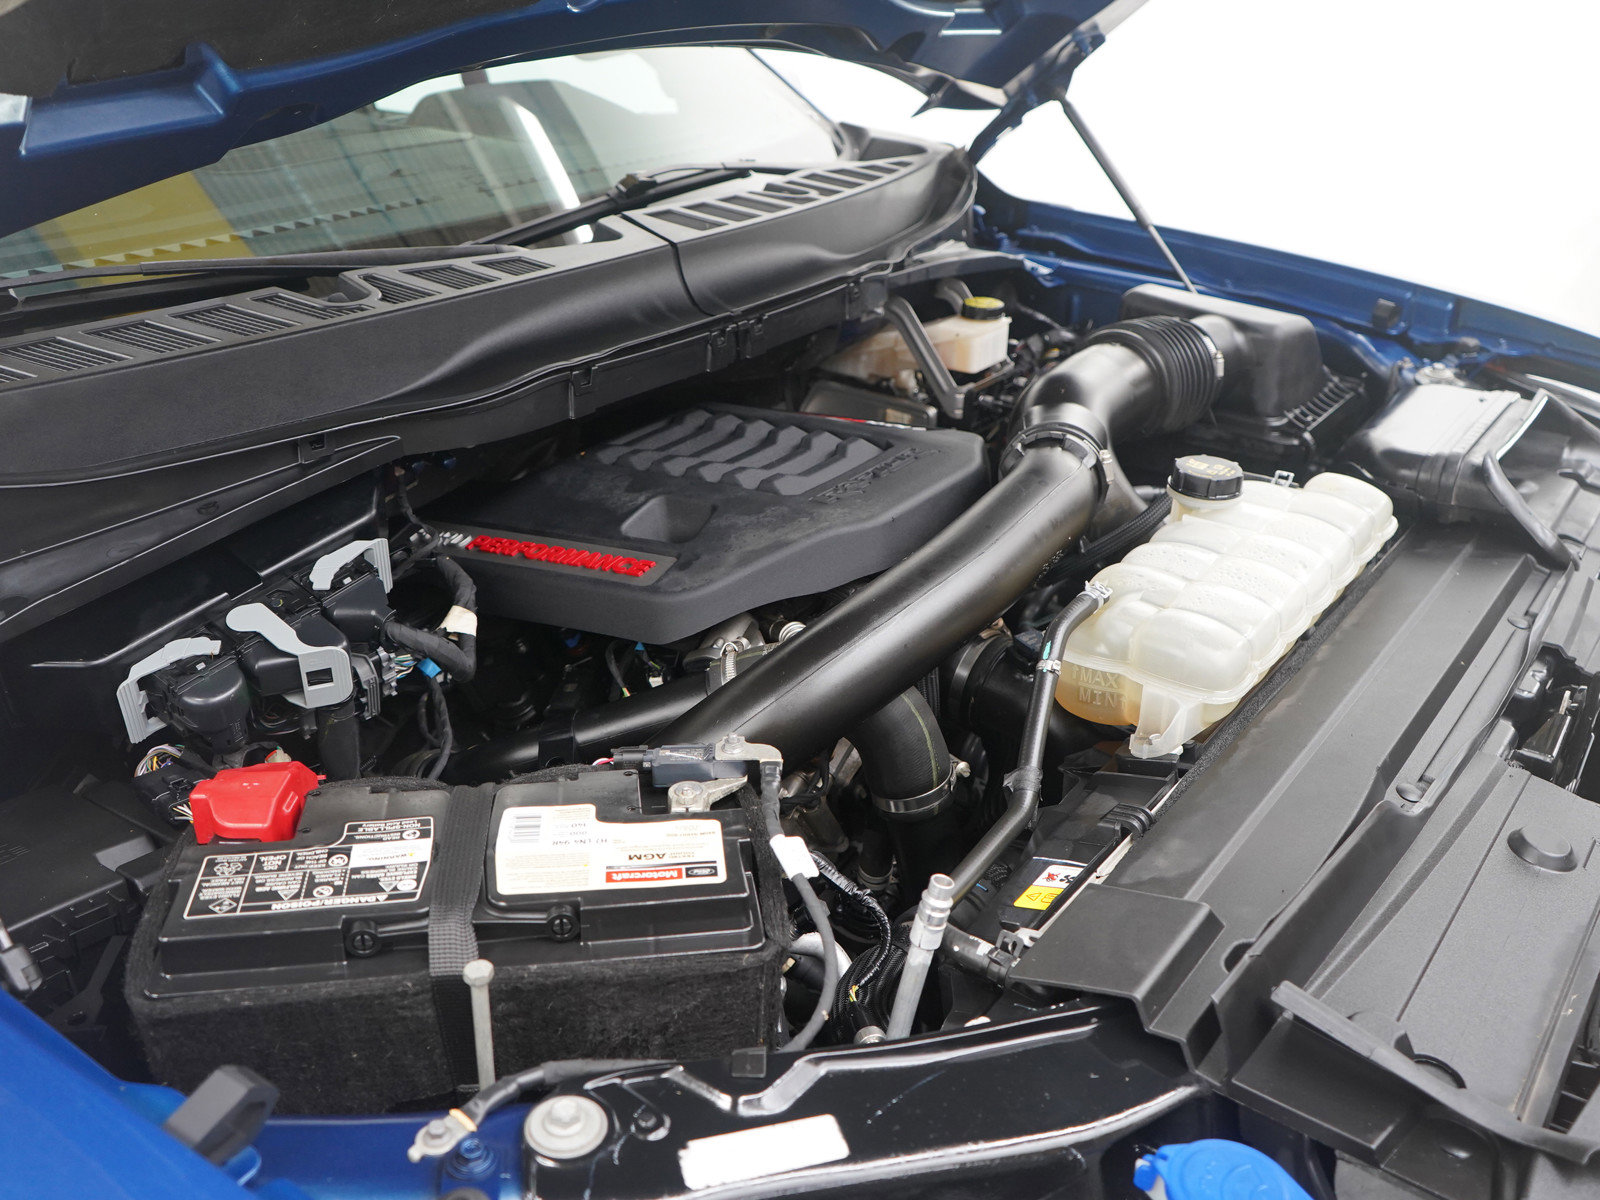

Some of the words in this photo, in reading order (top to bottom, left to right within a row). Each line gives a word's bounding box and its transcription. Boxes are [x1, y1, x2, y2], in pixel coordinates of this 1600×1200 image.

[466, 534, 656, 577] PERFORMANCE
[1080, 667, 1118, 688] MAX
[1079, 687, 1118, 708] MIN
[358, 823, 420, 832] NON-SPILLABLE
[612, 870, 678, 880] Motorcraft
[271, 896, 376, 910] DANGER/POISON
